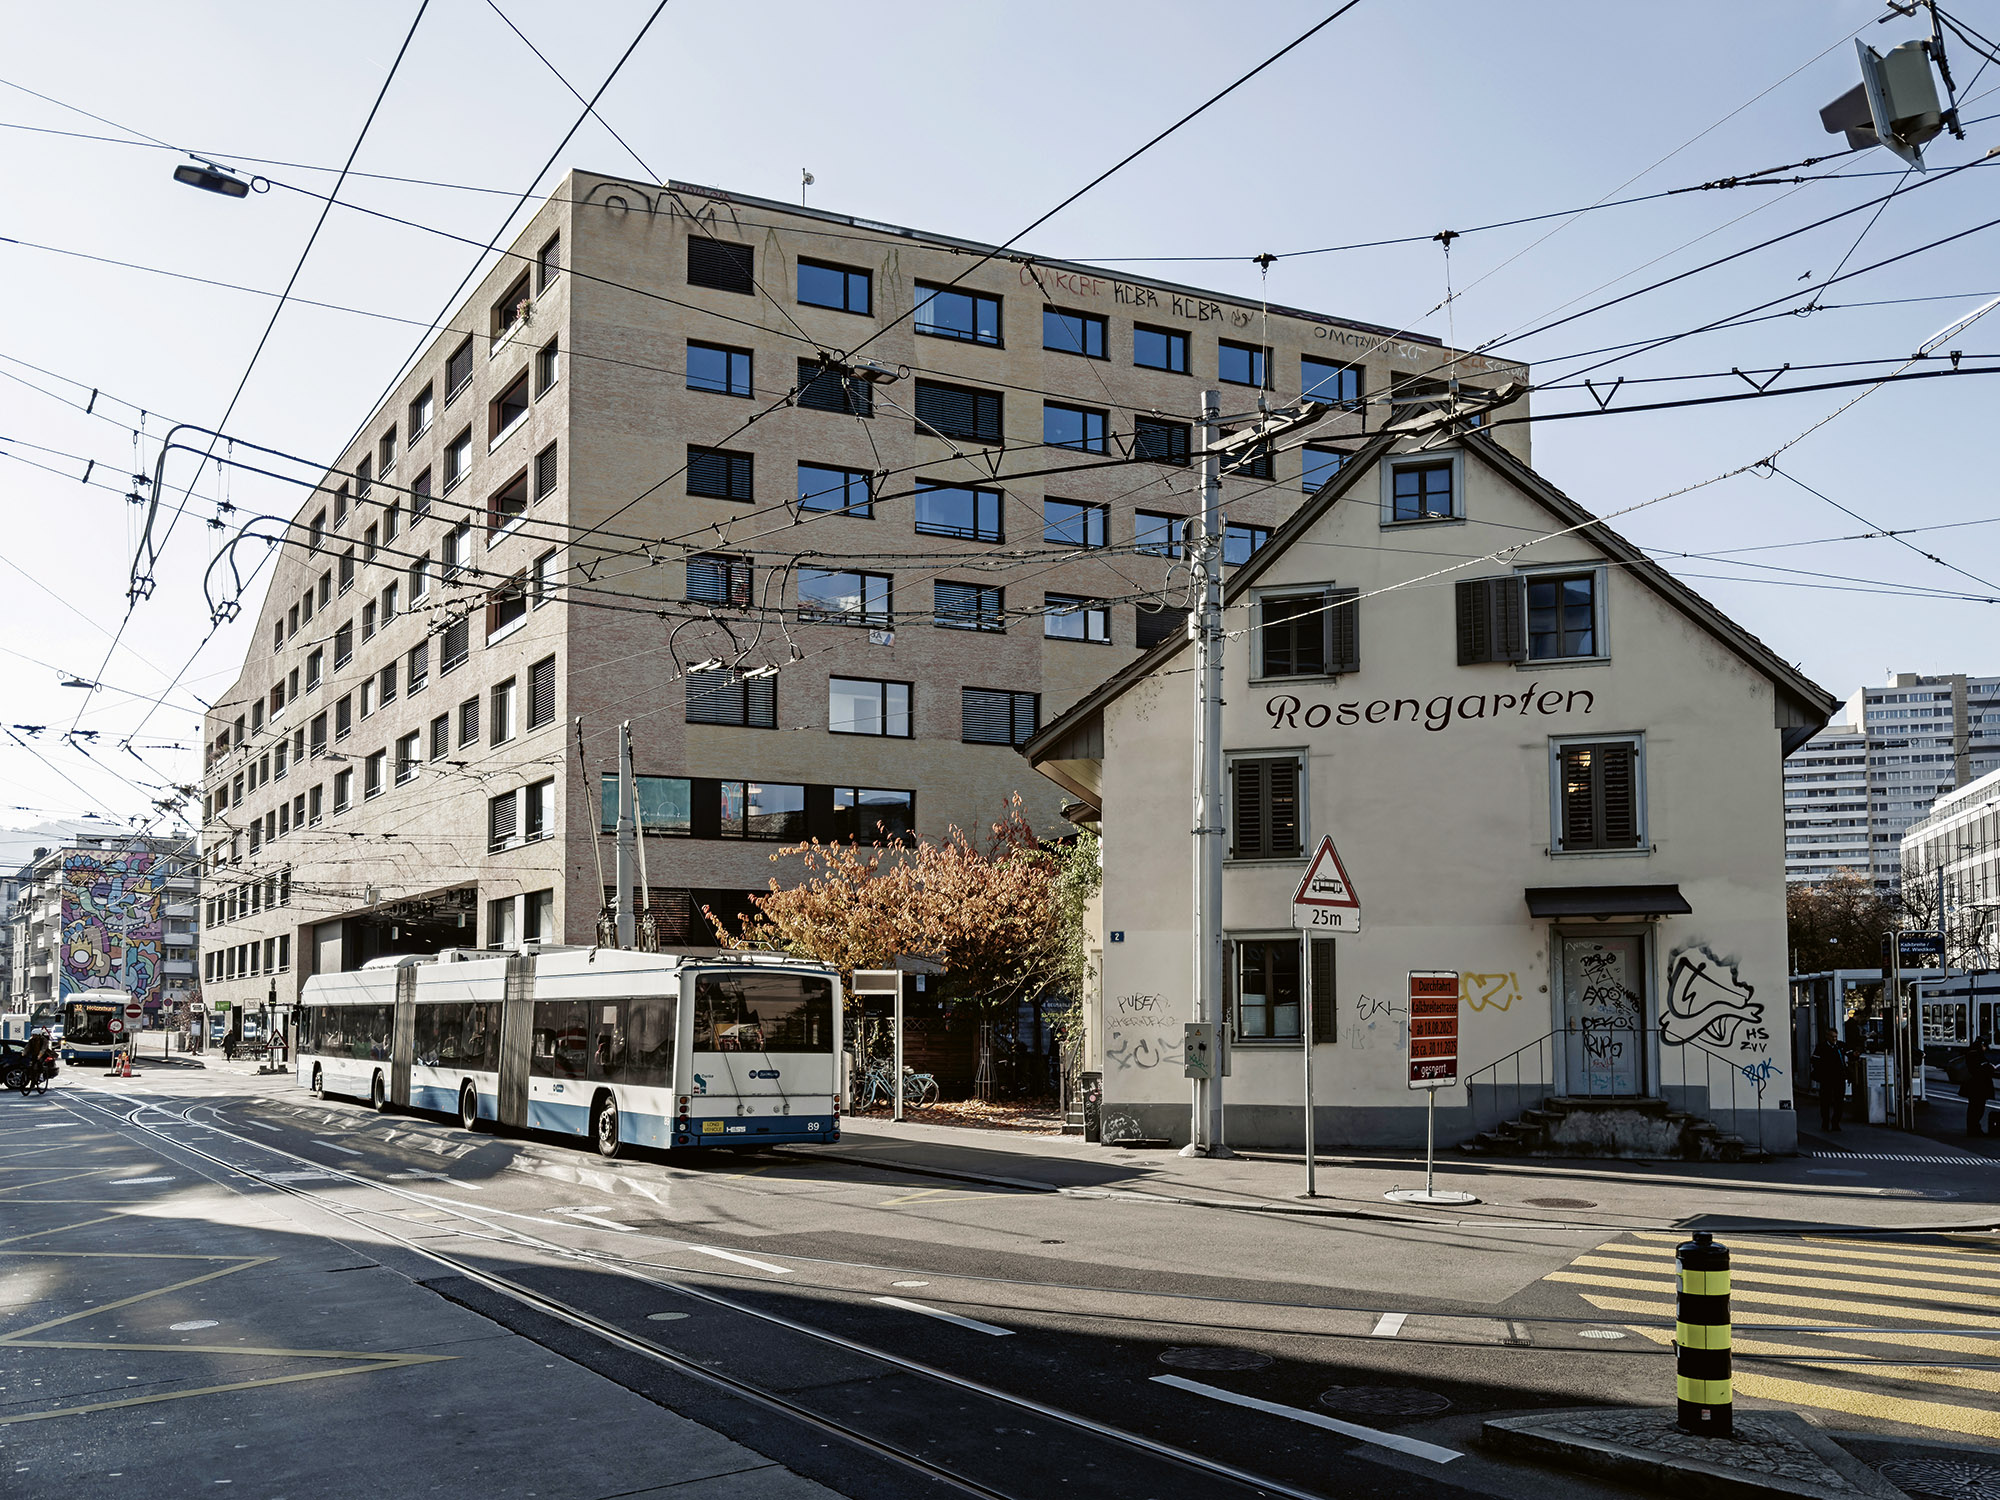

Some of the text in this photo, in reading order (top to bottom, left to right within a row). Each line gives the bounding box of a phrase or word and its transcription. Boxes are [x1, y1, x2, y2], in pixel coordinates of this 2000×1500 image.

[1265, 681, 1595, 732] Rosengarten
[1312, 908, 1342, 926] 25m
[1114, 932, 1120, 941] 2
[1418, 980, 1451, 992] Durchfahrt
[1411, 1000, 1457, 1014] Kalkbreitestrasse
[1424, 1021, 1453, 1034] 18.08.2025
[1428, 1040, 1457, 1055] 30.11.2025
[807, 1122, 820, 1131] 89
